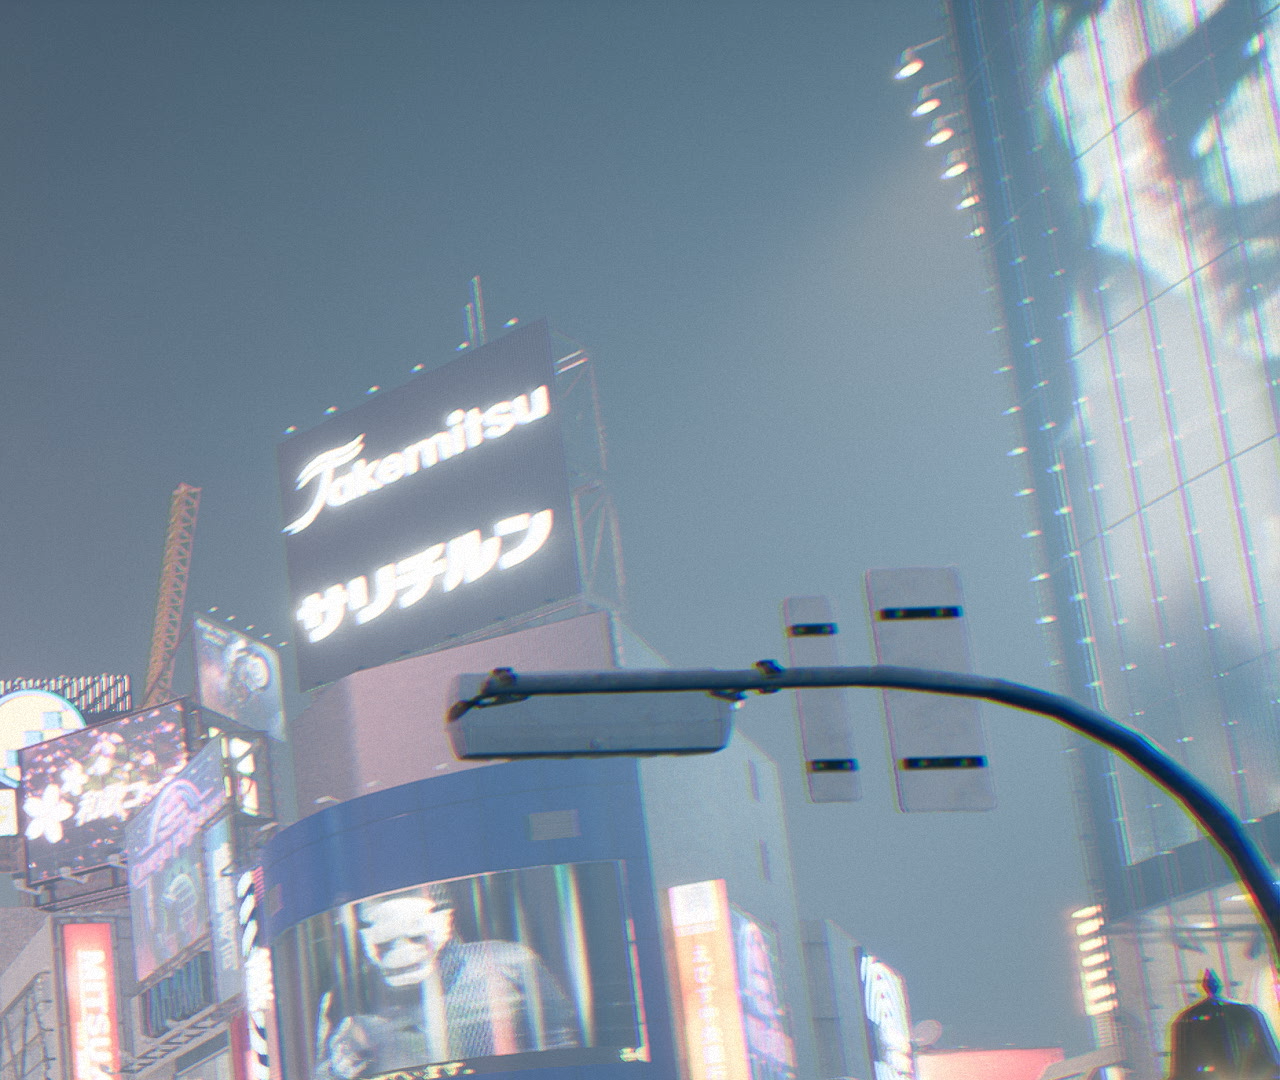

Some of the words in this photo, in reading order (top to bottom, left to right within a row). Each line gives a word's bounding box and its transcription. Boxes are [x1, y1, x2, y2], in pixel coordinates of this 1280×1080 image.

[281, 384, 553, 536] Takemitsu
[295, 507, 555, 643] サリチルン
